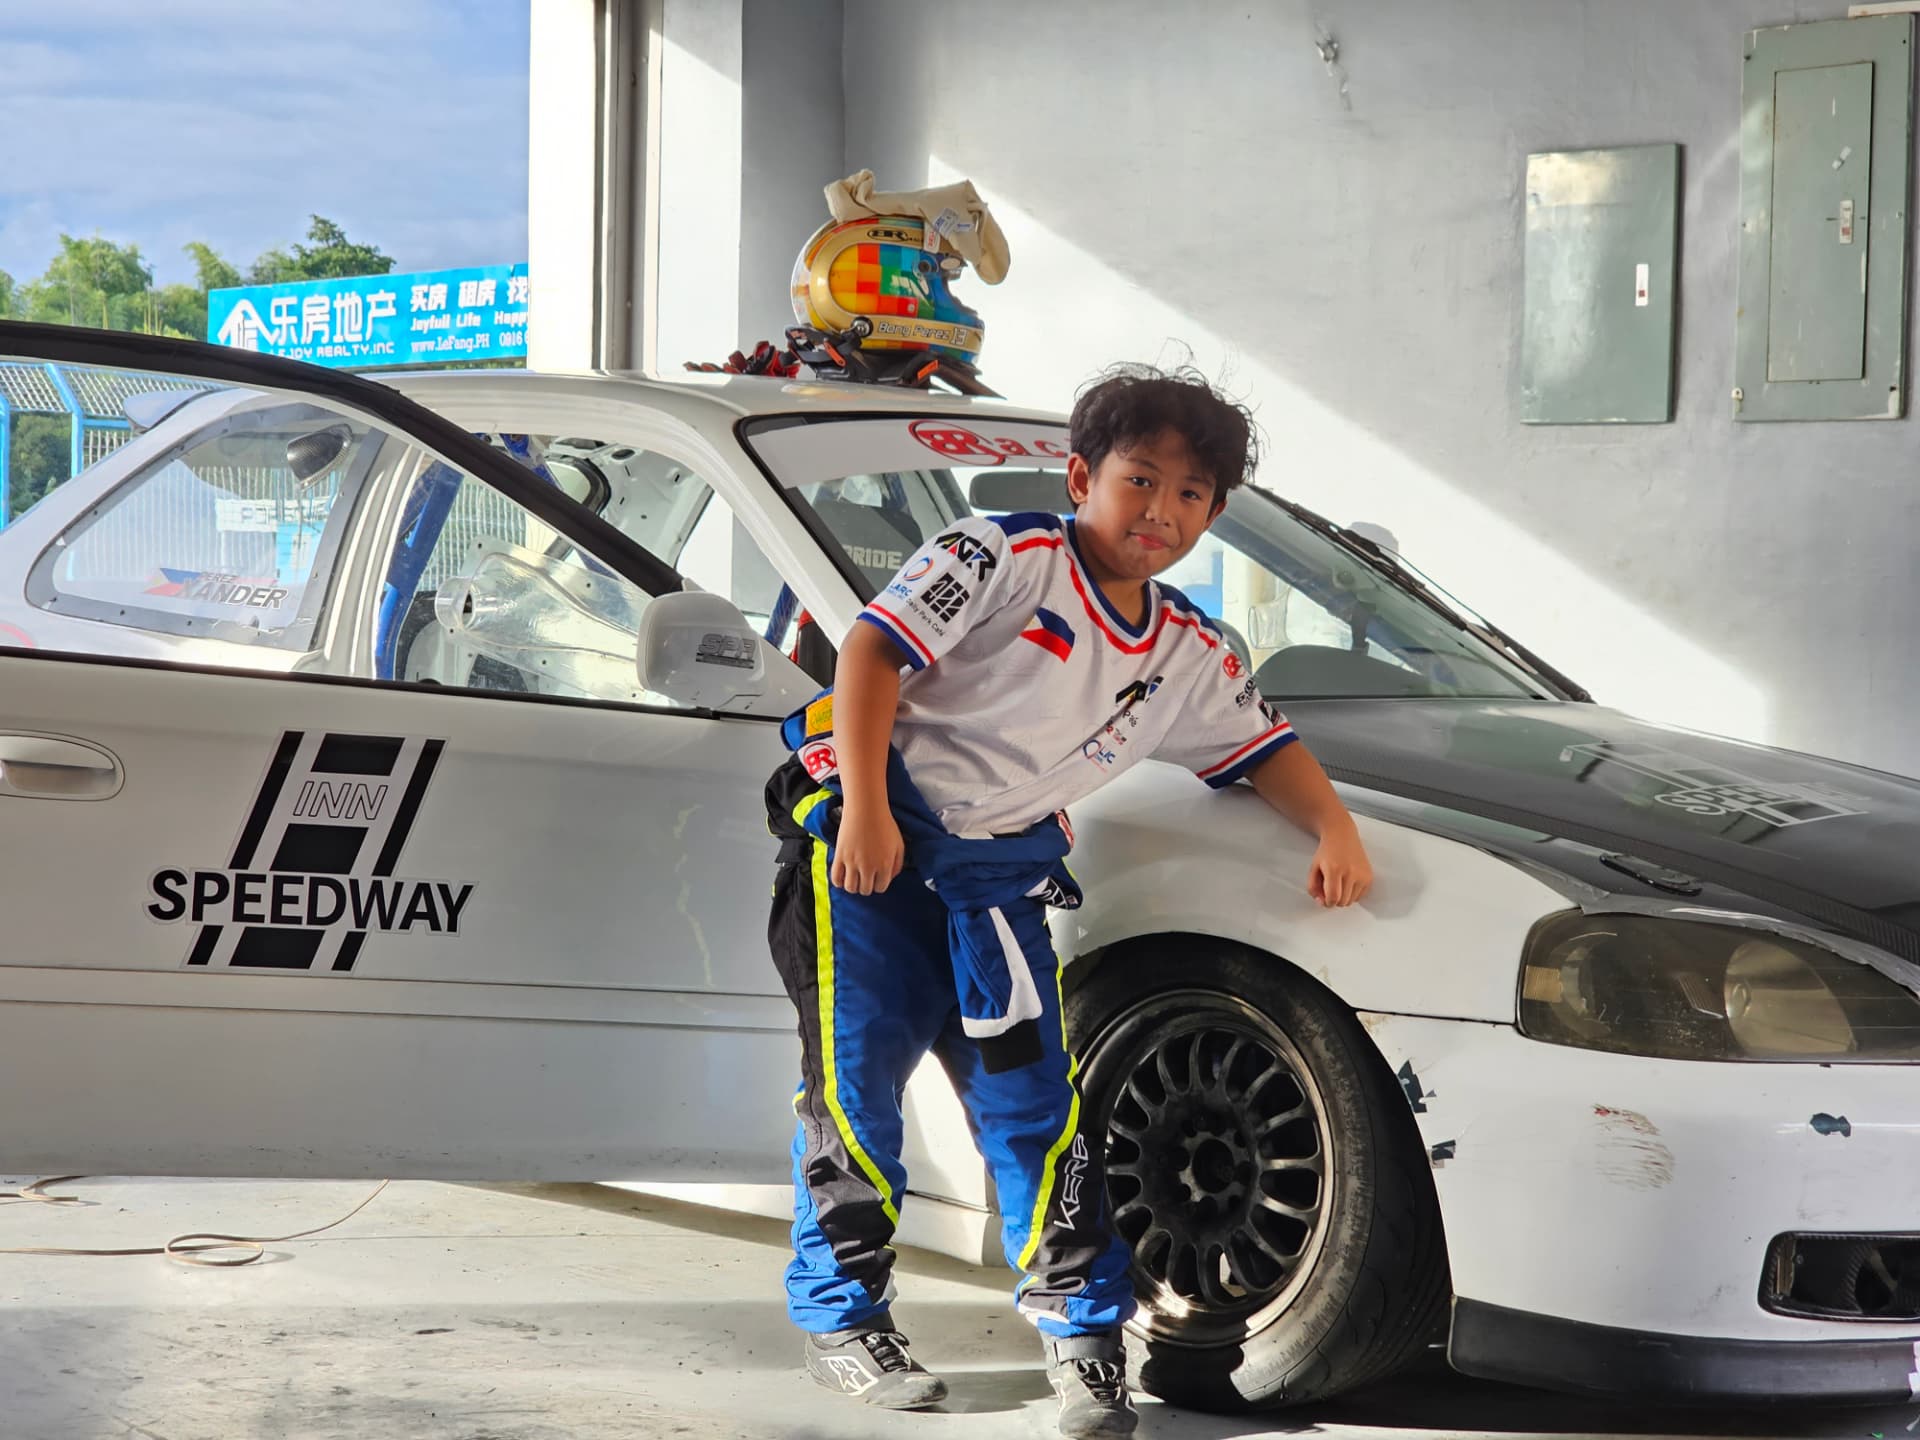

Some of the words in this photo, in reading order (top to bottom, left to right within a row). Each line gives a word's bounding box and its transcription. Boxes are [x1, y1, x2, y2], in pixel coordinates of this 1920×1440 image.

[270, 290, 397, 346] 乐房地产
[456, 312, 481, 327] Life
[293, 780, 388, 820] INN
[147, 869, 475, 934] SPEEDWAY
